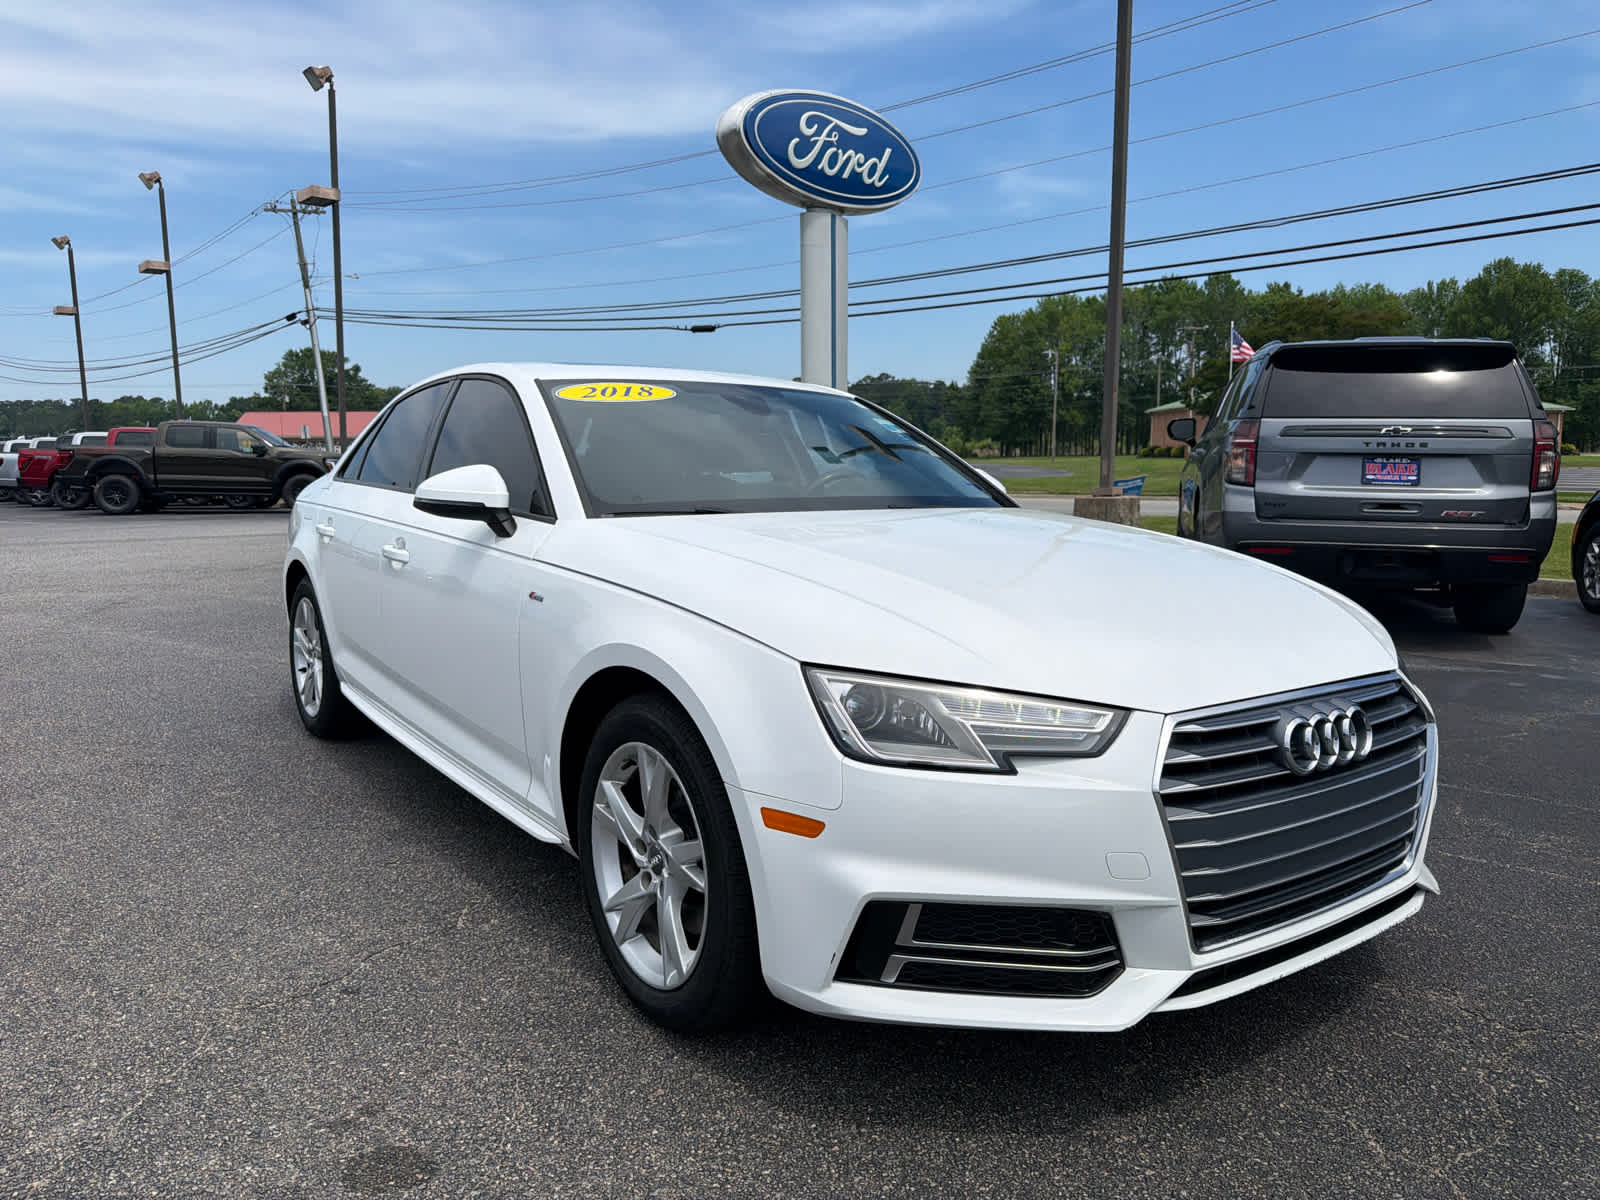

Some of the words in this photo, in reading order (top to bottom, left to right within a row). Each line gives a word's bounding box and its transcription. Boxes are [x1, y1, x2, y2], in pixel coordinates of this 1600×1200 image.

[787, 111, 892, 188] Ford
[581, 386, 653, 398] 2018
[1363, 441, 1429, 449] TAHOE
[1365, 463, 1417, 475] BLAKE
